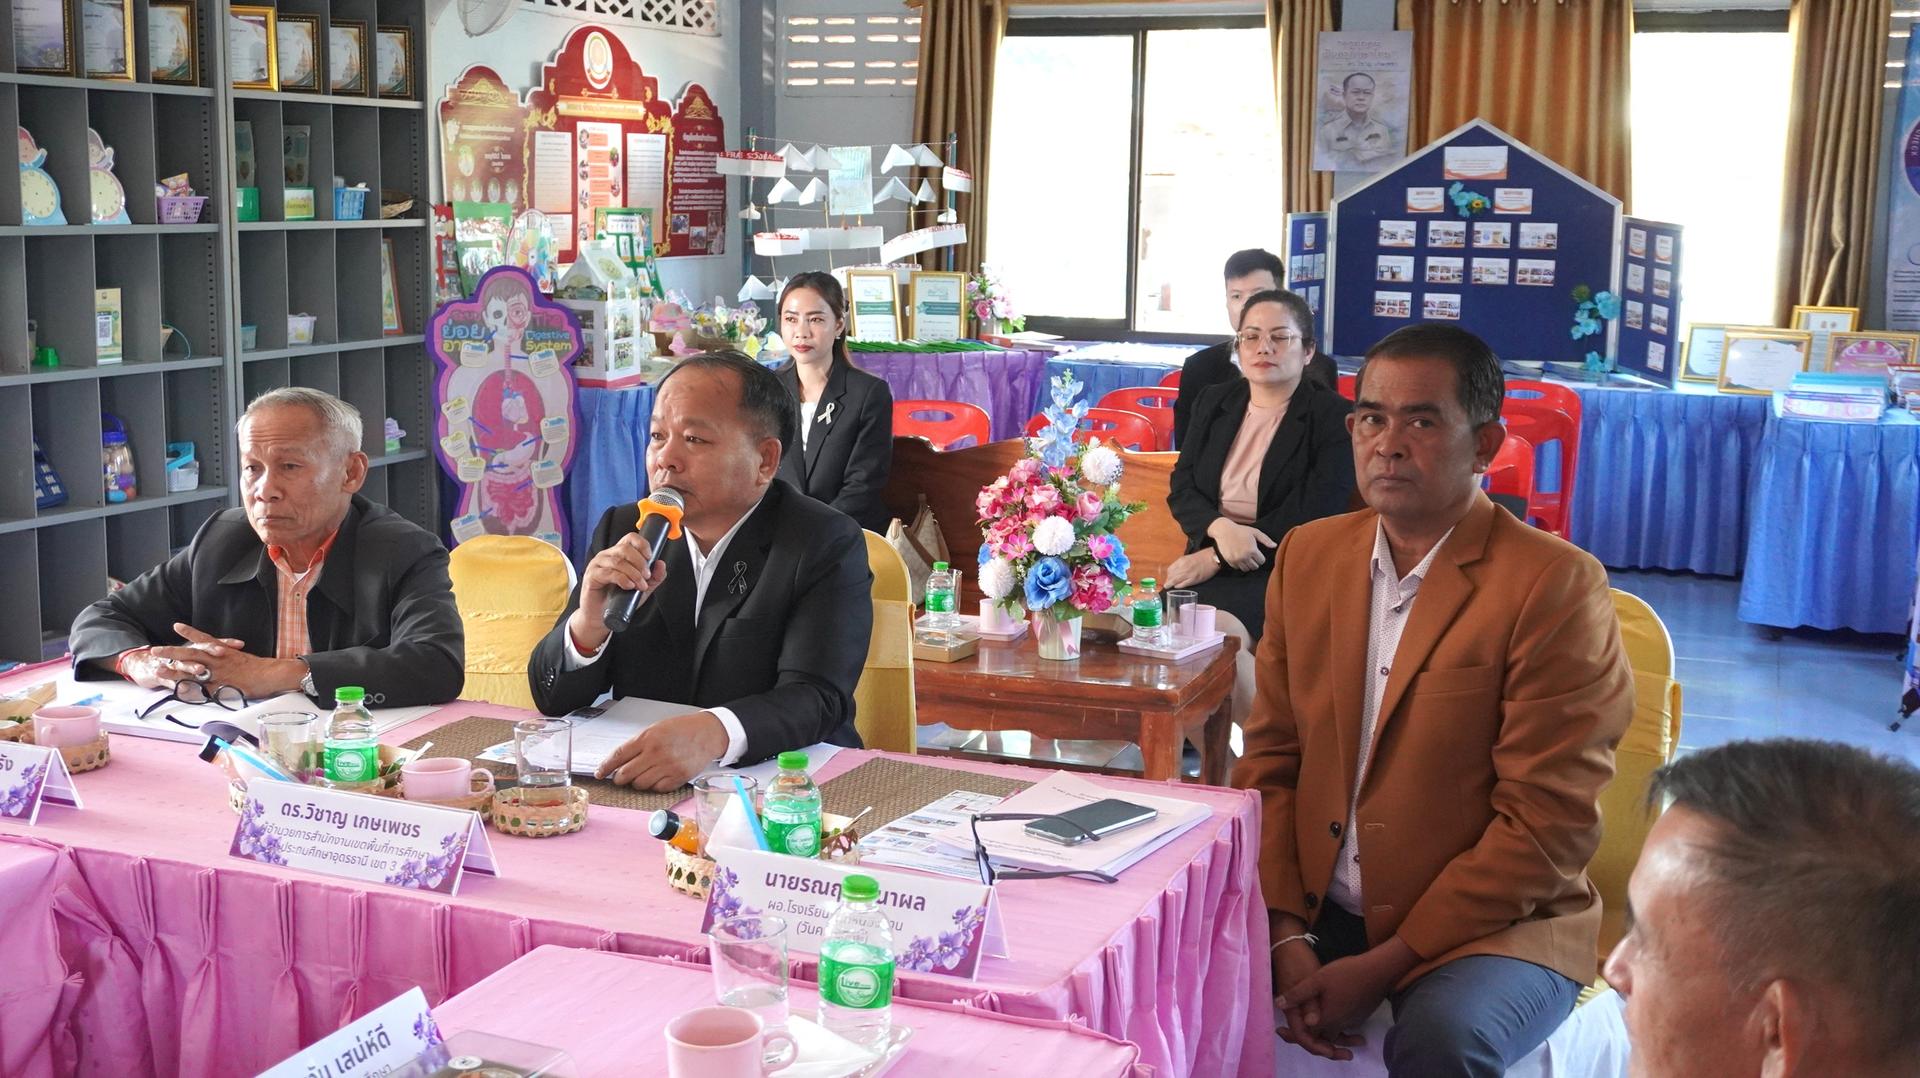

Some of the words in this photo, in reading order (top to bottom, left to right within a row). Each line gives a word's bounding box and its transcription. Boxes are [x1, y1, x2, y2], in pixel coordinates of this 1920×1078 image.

[442, 318, 486, 340] ย่อย
[526, 330, 570, 341] Digestive
[526, 340, 572, 353] System
[281, 799, 348, 830] ดร.วิชาญ
[353, 812, 421, 838] เกษเพชร
[370, 859, 387, 870] เขต
[389, 861, 398, 871] 3
[765, 871, 843, 903] นายรณฤ
[334, 1022, 392, 1075] เสน่ห์ดี
